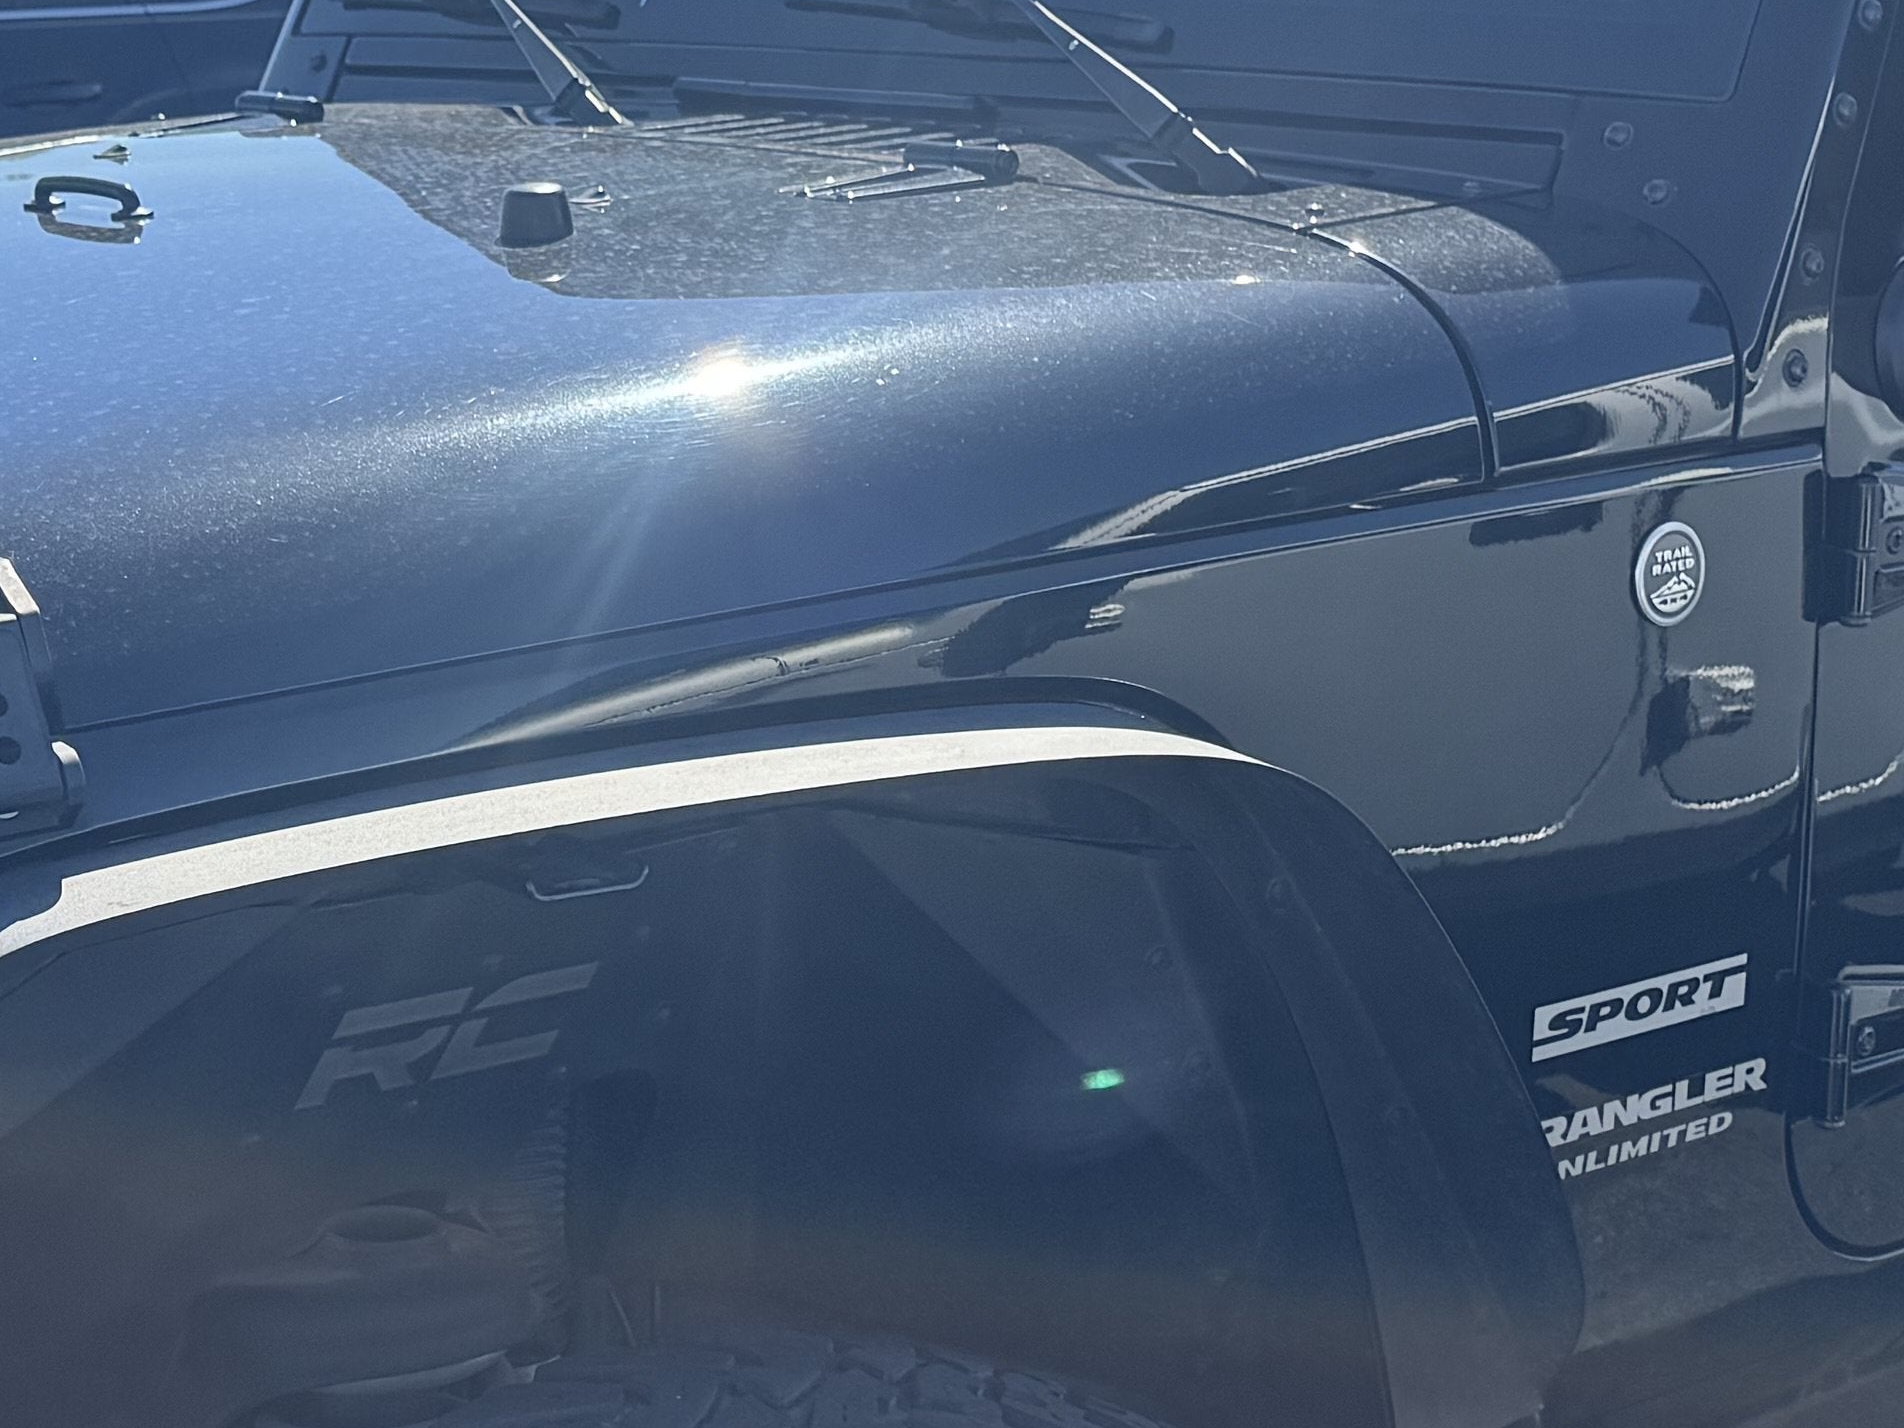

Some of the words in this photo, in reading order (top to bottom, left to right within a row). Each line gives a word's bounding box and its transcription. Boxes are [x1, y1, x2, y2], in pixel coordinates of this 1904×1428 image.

[1652, 558, 1695, 577] RATED
[1655, 545, 1693, 563] TRAIL
[296, 962, 600, 1110] RC
[1533, 963, 1746, 1048] SPORT
[1541, 1058, 1768, 1148] RANGLER
[1558, 1112, 1733, 1180] NLIMITED
